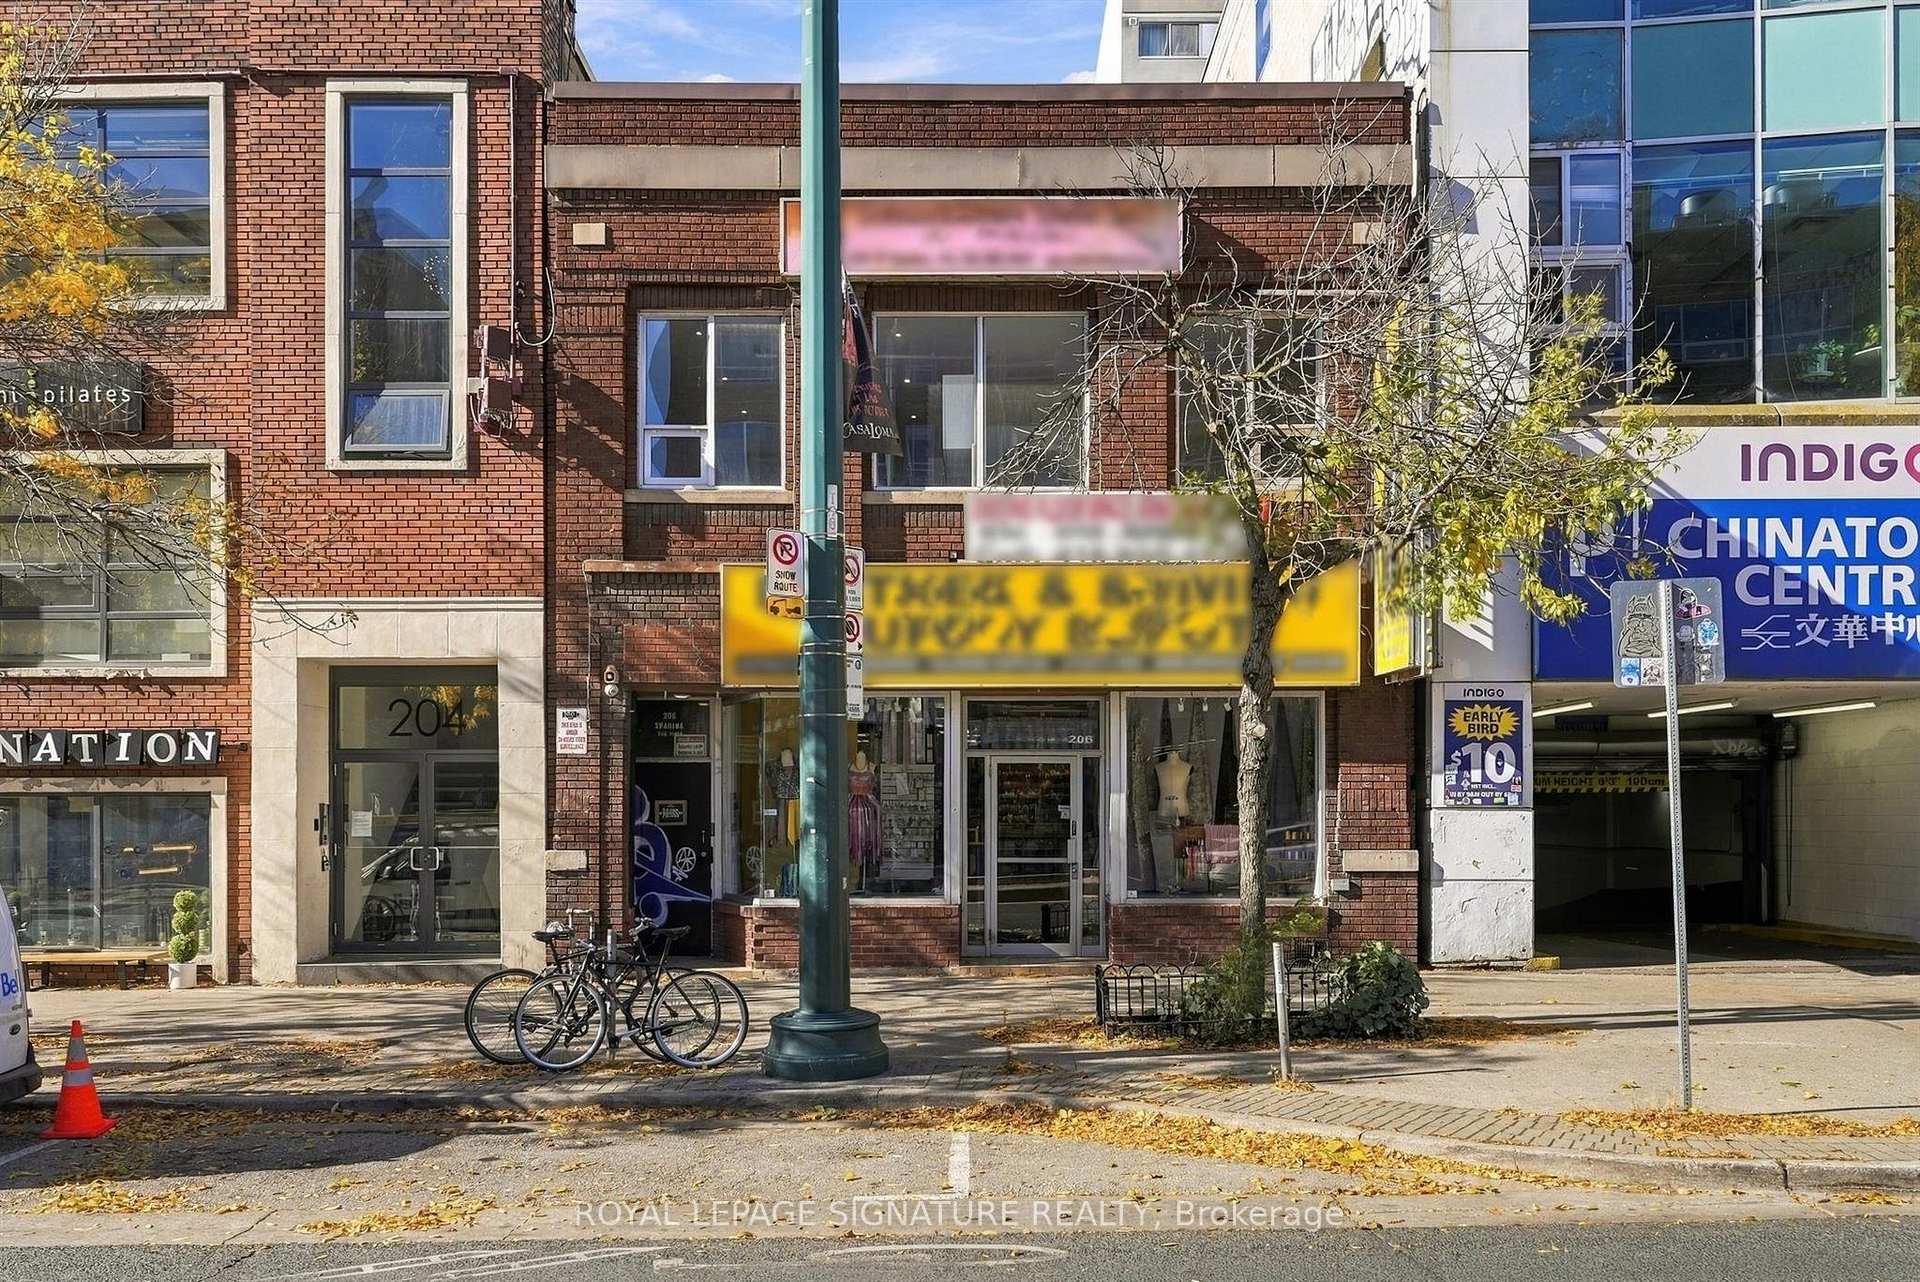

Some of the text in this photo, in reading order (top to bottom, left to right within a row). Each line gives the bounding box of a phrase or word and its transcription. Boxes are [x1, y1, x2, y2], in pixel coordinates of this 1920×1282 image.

[44, 385, 131, 403] pilates
[1667, 516, 1918, 559] CHINATO
[773, 582, 798, 593] ROUTE
[1735, 564, 1915, 606] CENTR
[1463, 688, 1505, 698] INDIGO
[388, 699, 467, 736] 204
[1463, 711, 1504, 723] EARLY
[1467, 723, 1500, 735] BIRD
[0, 732, 216, 763] NATION
[1451, 741, 1516, 784] $10
